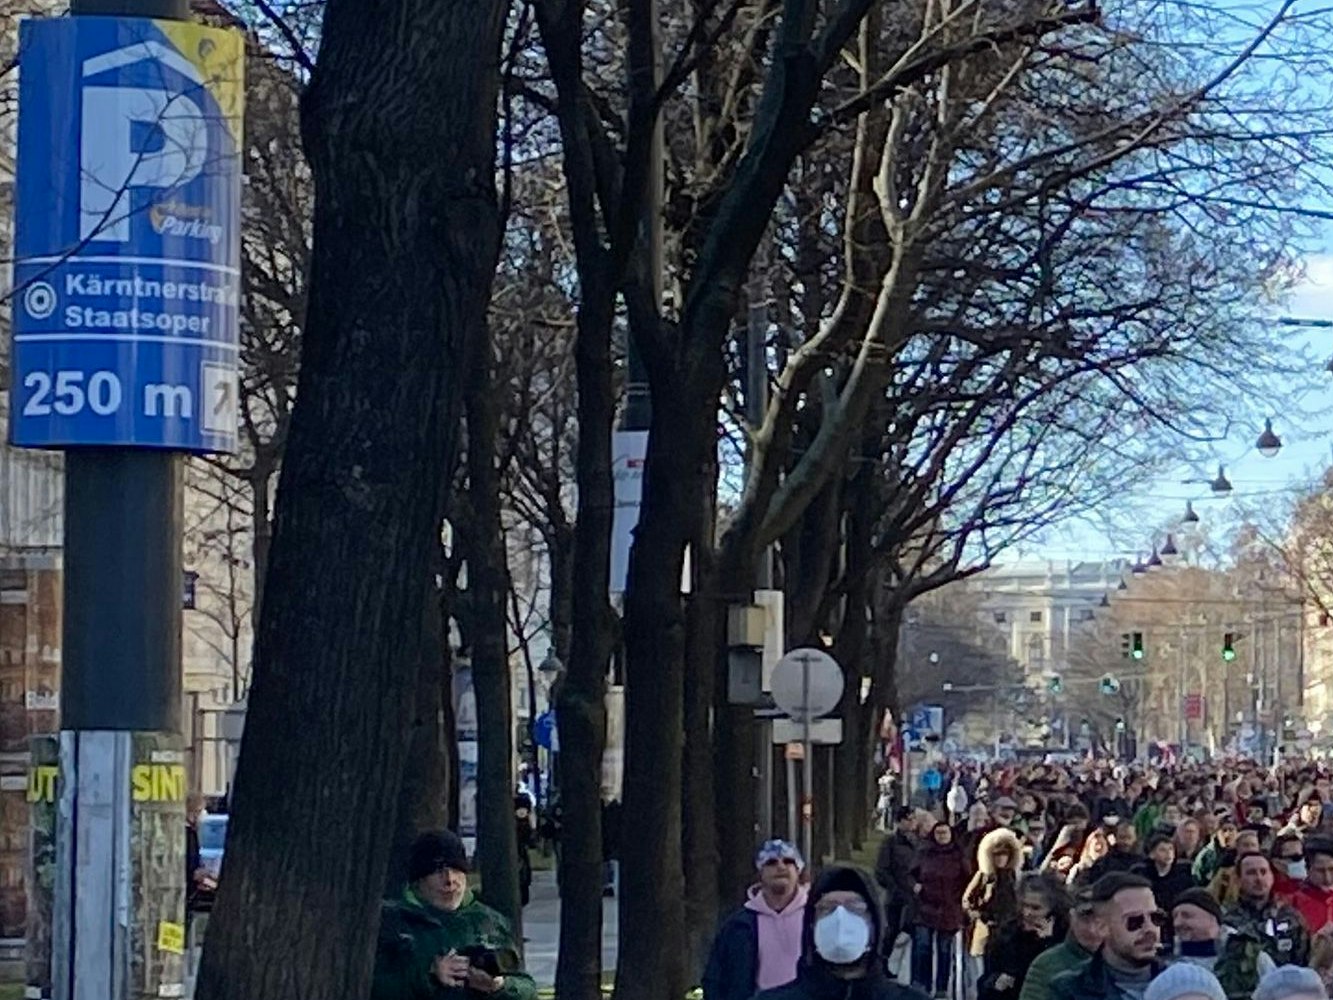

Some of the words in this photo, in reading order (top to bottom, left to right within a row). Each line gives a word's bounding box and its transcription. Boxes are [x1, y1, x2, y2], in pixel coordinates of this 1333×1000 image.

[65, 305, 210, 335] Staatsoper
[23, 370, 122, 416] 250
[144, 383, 192, 418] m
